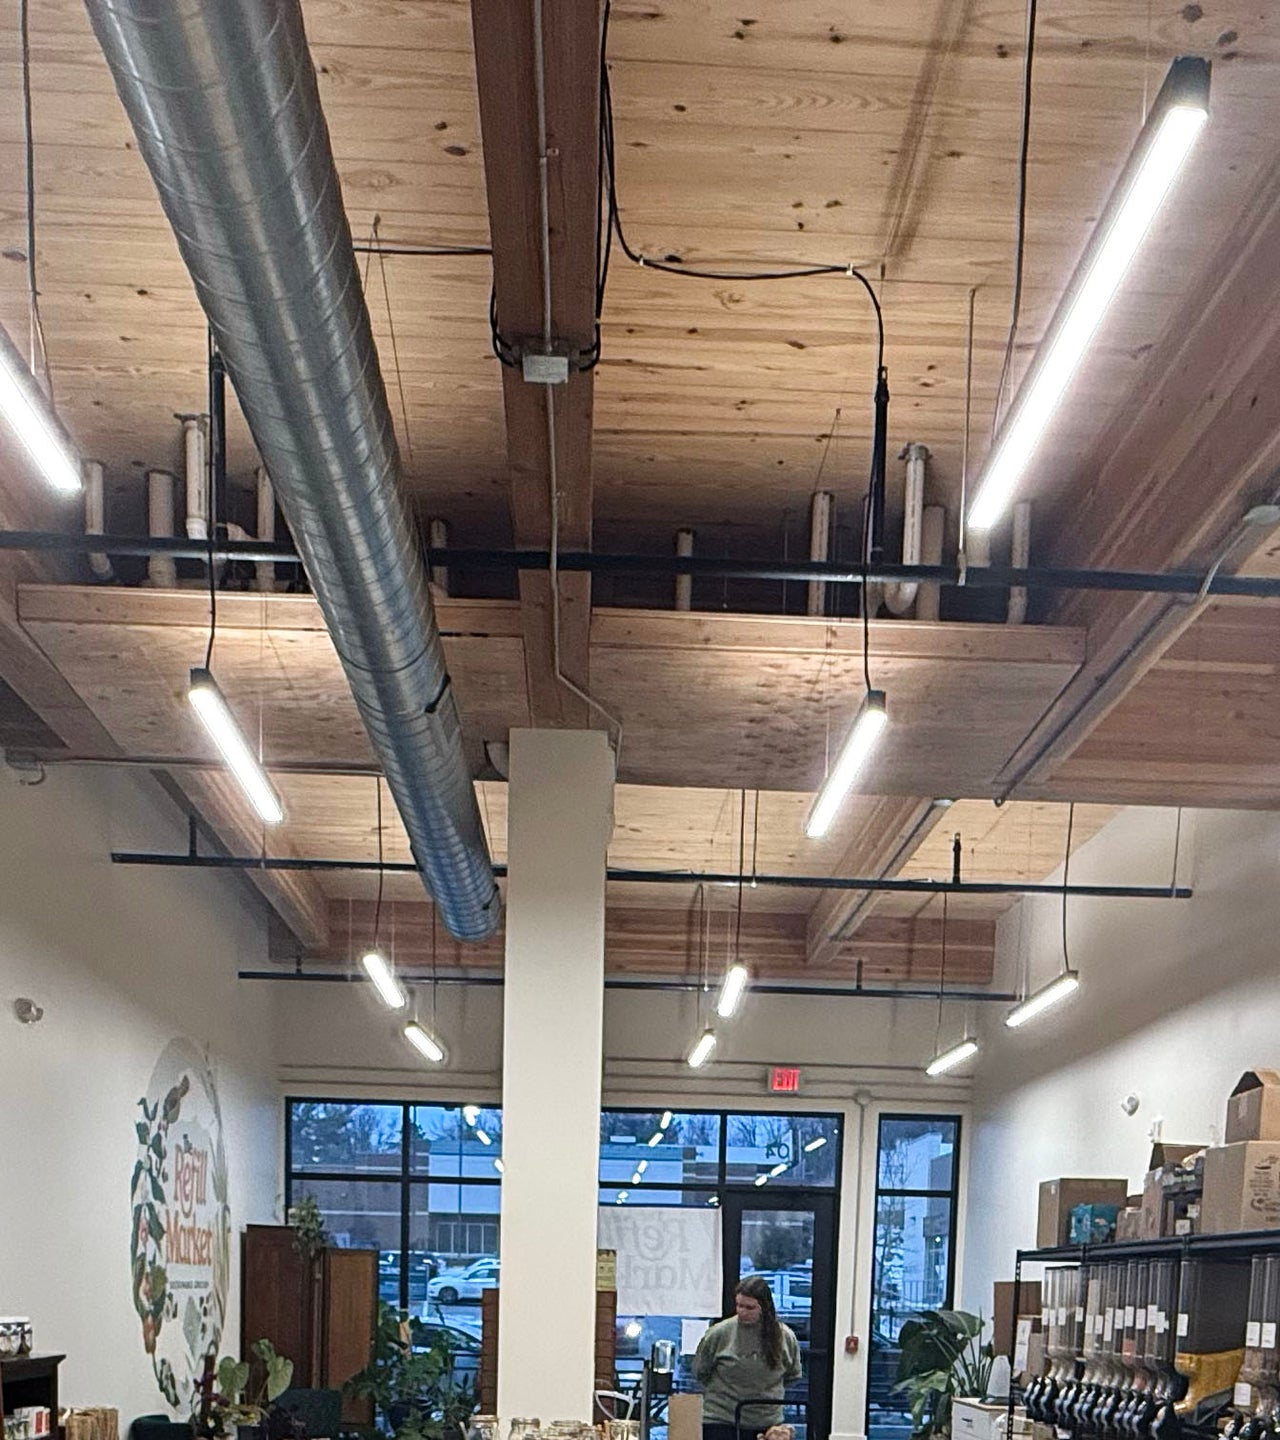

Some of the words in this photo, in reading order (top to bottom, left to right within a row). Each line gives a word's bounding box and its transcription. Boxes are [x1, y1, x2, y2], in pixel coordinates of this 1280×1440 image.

[773, 1067, 800, 1090] EXIT
[174, 1144, 208, 1218] Refill
[166, 1208, 213, 1266] Market
